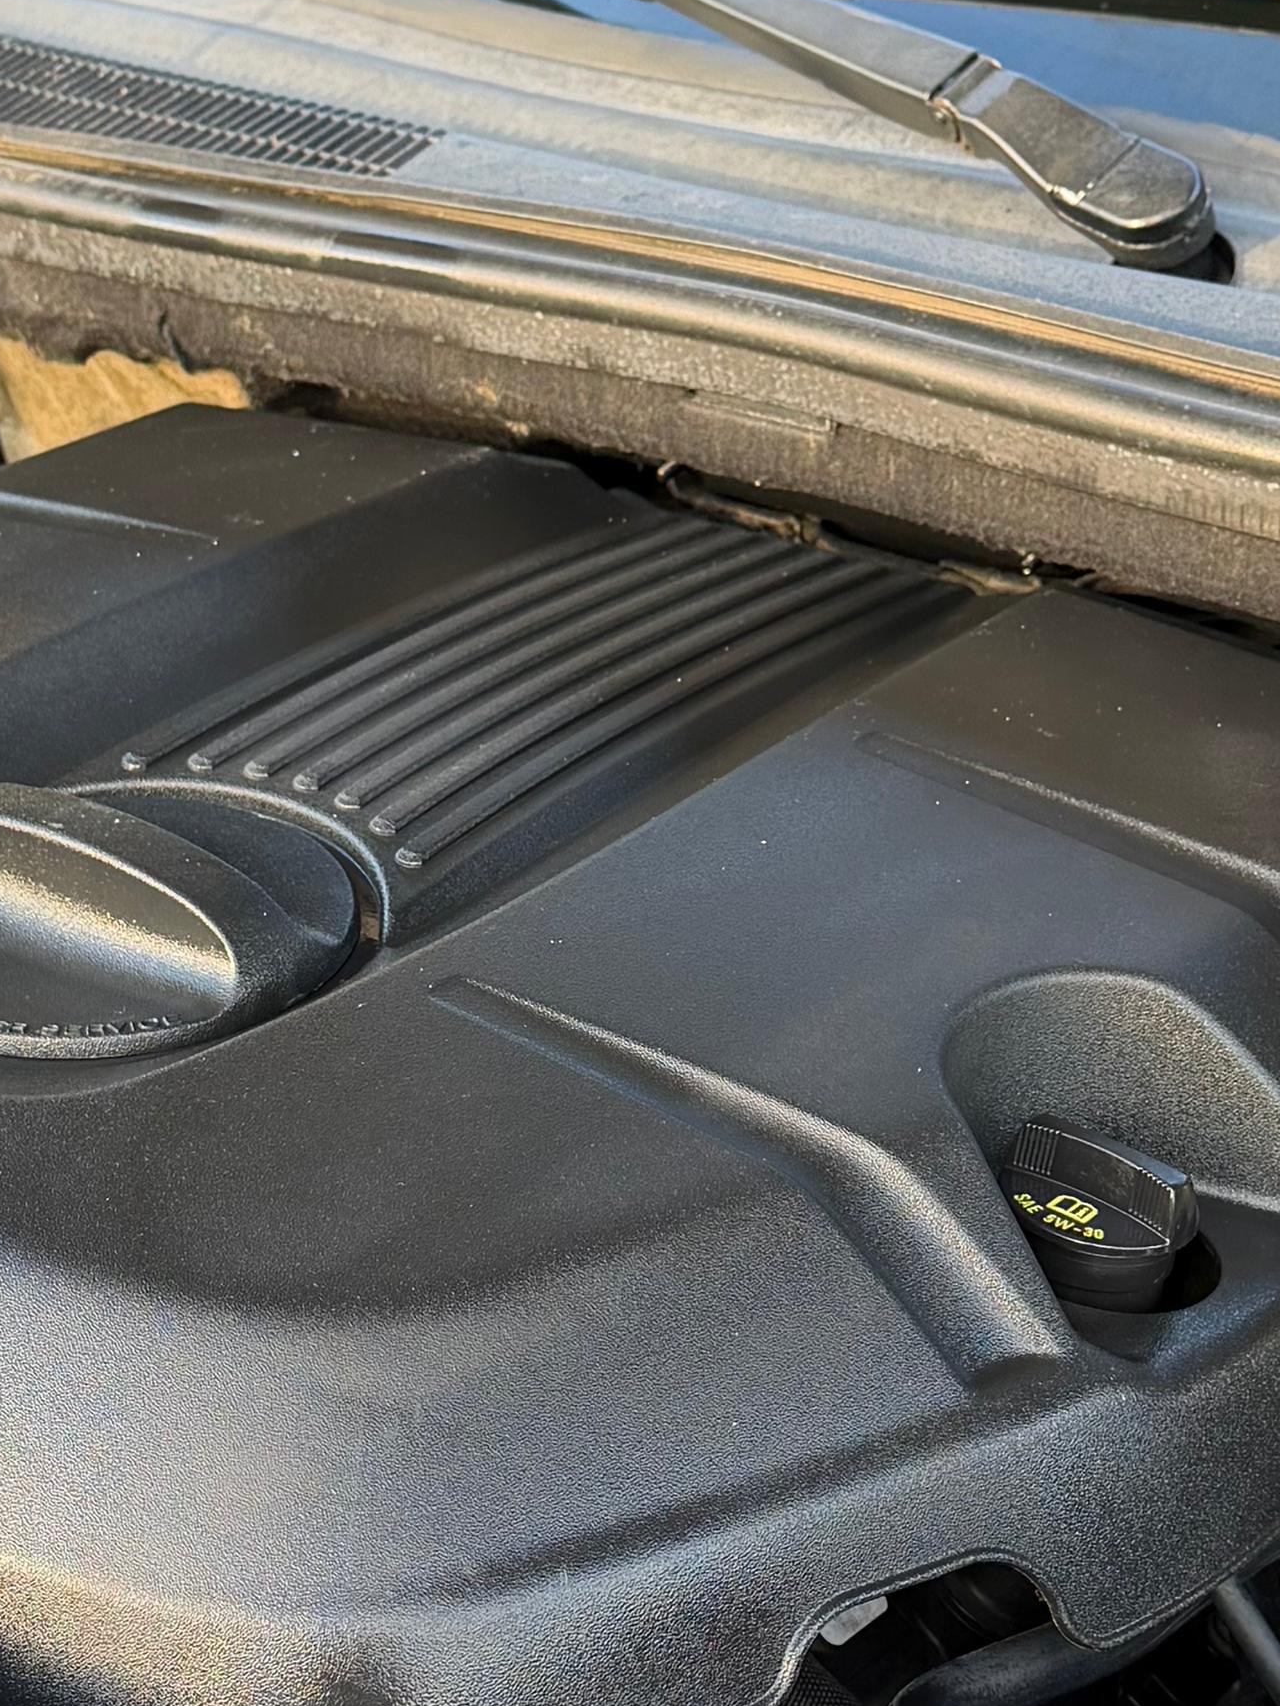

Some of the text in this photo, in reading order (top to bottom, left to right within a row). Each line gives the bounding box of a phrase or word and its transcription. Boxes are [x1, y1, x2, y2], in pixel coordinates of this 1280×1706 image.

[35, 1014, 184, 1038] SERVICE
[1012, 1192, 1105, 1240] SAE 5W-30
